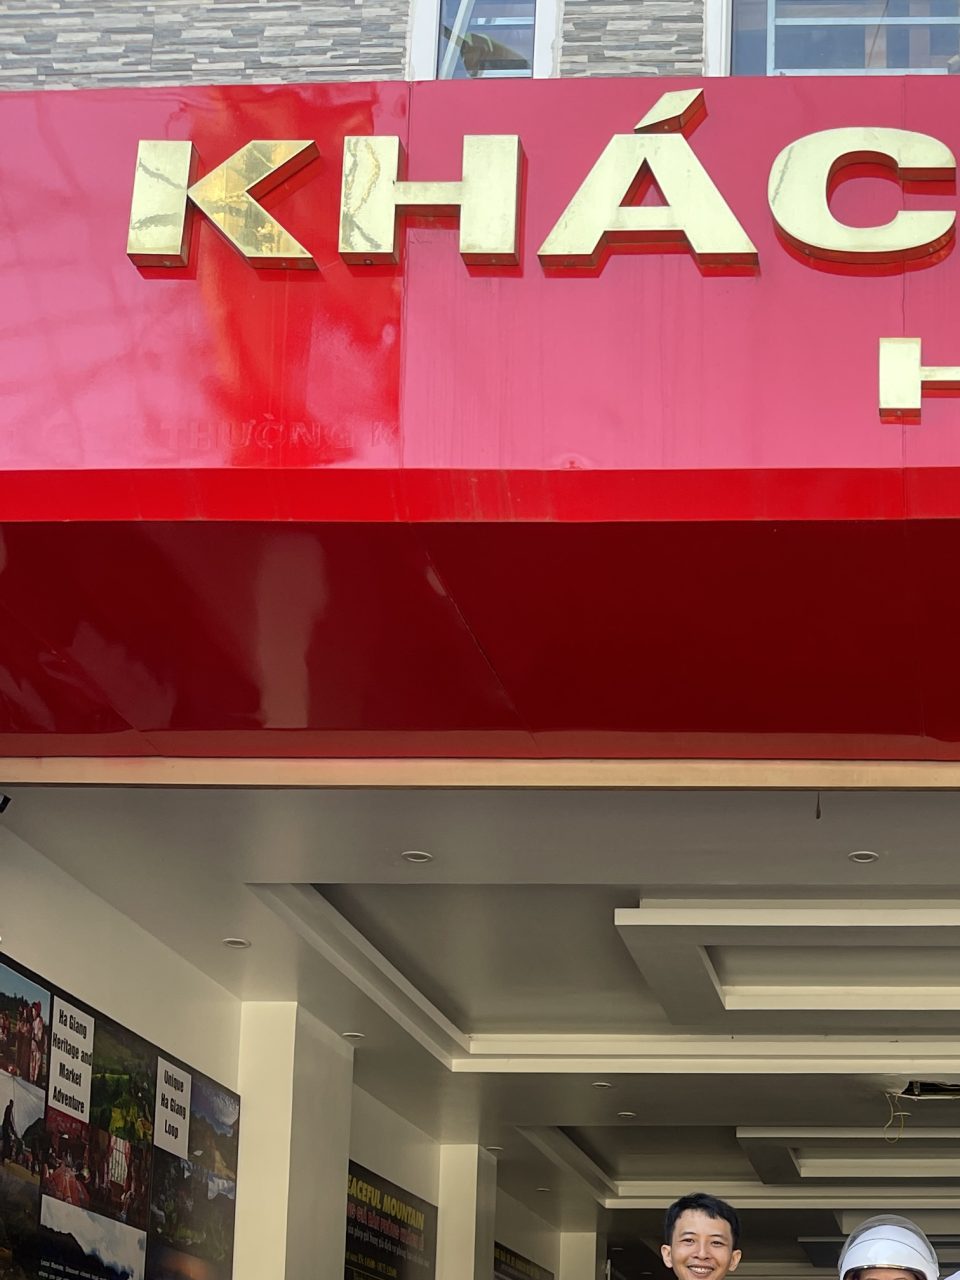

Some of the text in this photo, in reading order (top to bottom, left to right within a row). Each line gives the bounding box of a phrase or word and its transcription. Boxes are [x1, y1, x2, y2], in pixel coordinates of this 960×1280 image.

[58, 1008, 87, 1039] Ha Giang
[52, 1032, 93, 1066] Heritage and
[59, 1062, 82, 1087] Market
[163, 1069, 184, 1093] Unique
[52, 1086, 85, 1114] Adventure
[161, 1092, 186, 1120] Ha Giang
[164, 1119, 179, 1140] Loop
[382, 1194, 425, 1231] MOUNTAIN
